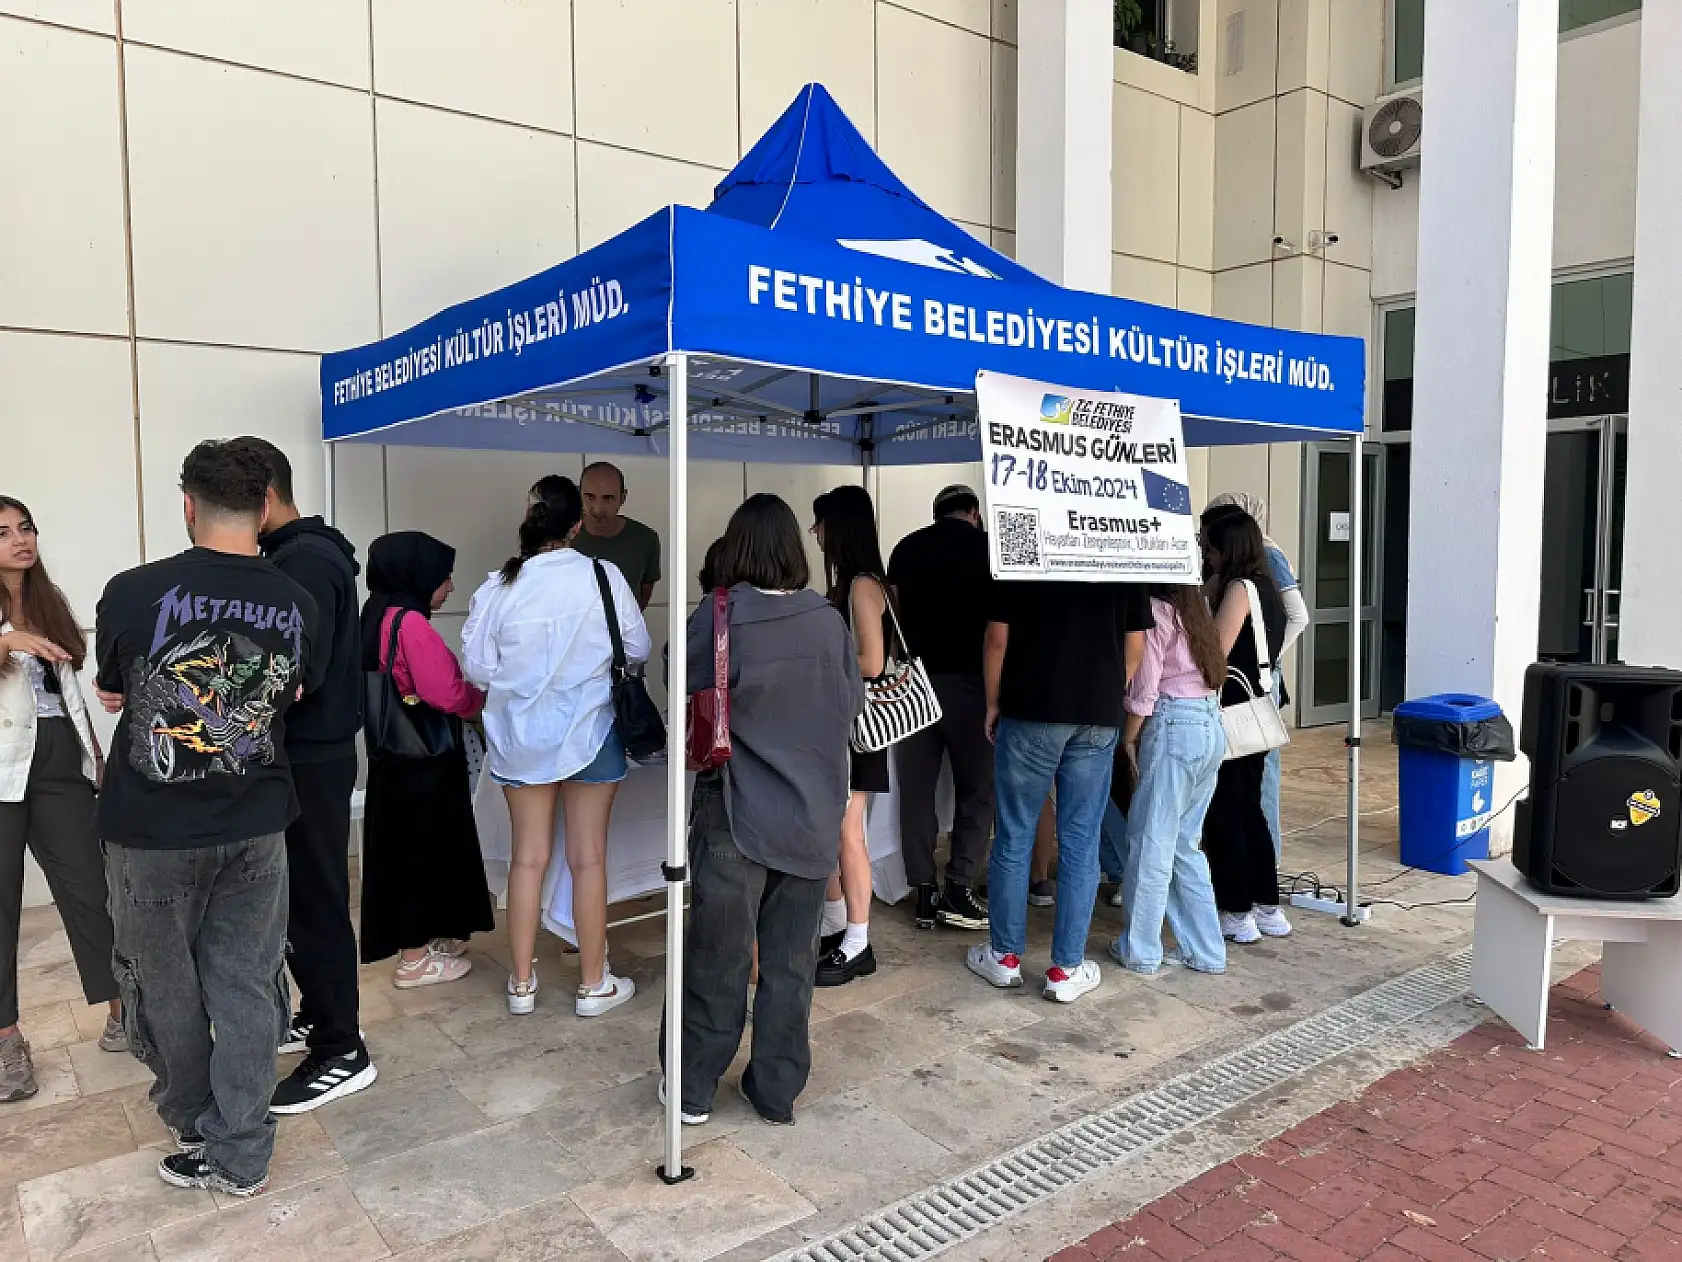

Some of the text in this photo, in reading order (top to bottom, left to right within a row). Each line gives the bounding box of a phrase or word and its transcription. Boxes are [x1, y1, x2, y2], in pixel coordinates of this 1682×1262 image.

[334, 276, 630, 405] FETHİYE BELEDİYESİ KÜLTÜR İŞLERİ MÜD.
[748, 264, 1335, 391] FETHİYE BELEDİYESİ KÜLTÜR İŞLERİ MÜD.
[988, 421, 1177, 465] ERASMUS GÜNLERİ
[991, 452, 1138, 500] 17-18 Ekim 2024
[1067, 510, 1162, 534] Erasmus+
